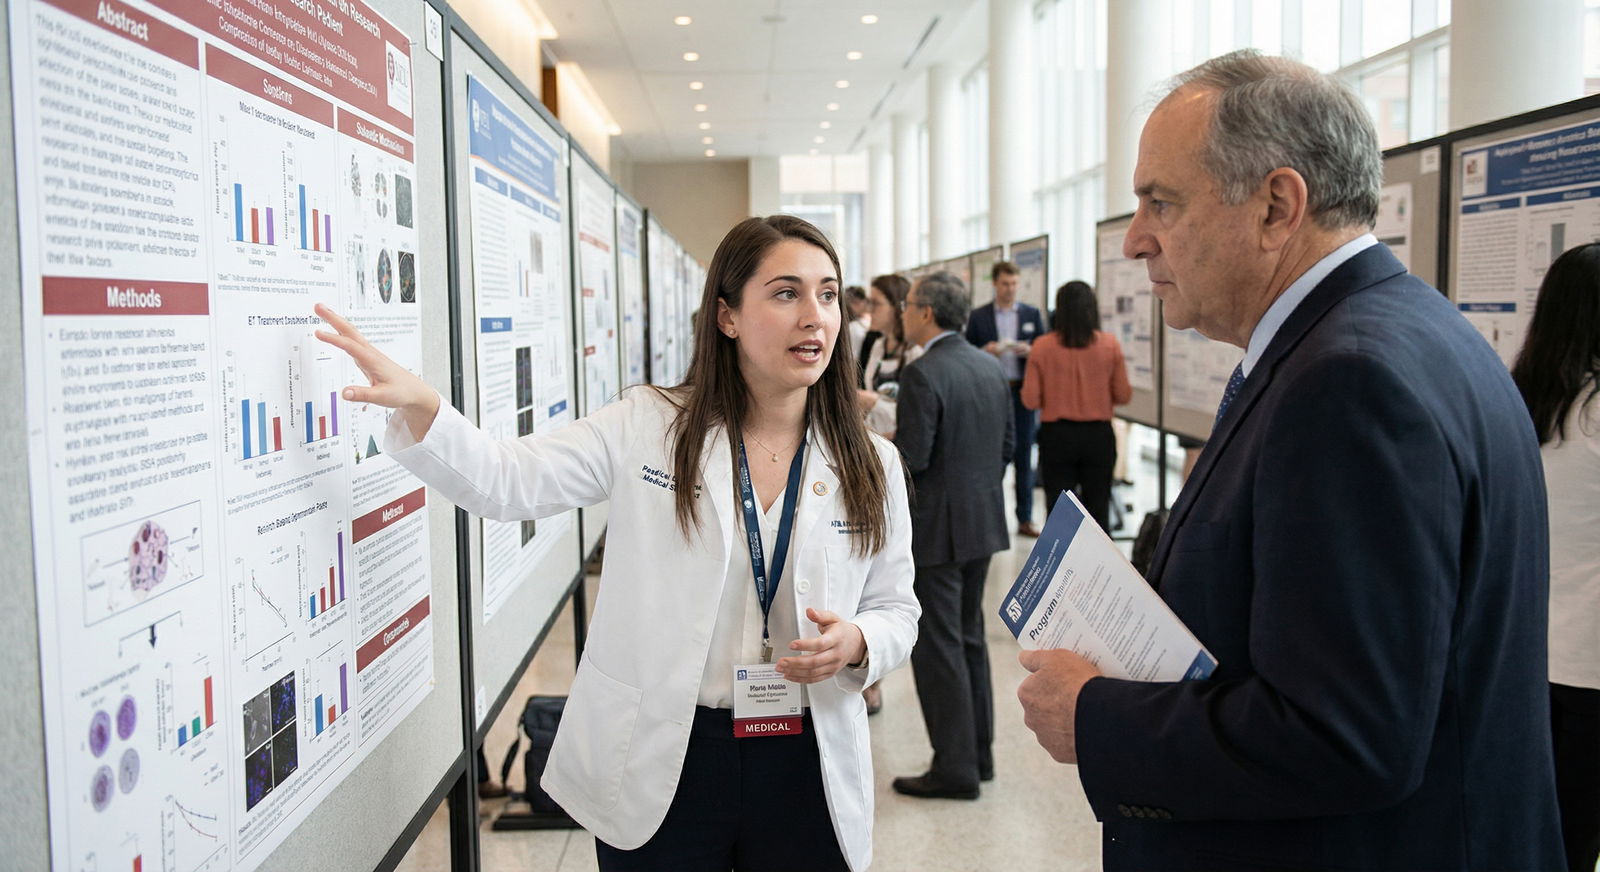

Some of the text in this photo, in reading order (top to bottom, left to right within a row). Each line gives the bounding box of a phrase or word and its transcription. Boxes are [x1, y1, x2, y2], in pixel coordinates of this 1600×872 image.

[97, 0, 149, 41] Abstract
[350, 2, 381, 40] Research
[107, 286, 161, 308] Methods
[1030, 599, 1058, 641] Program
[745, 722, 791, 733] MEDICAL
